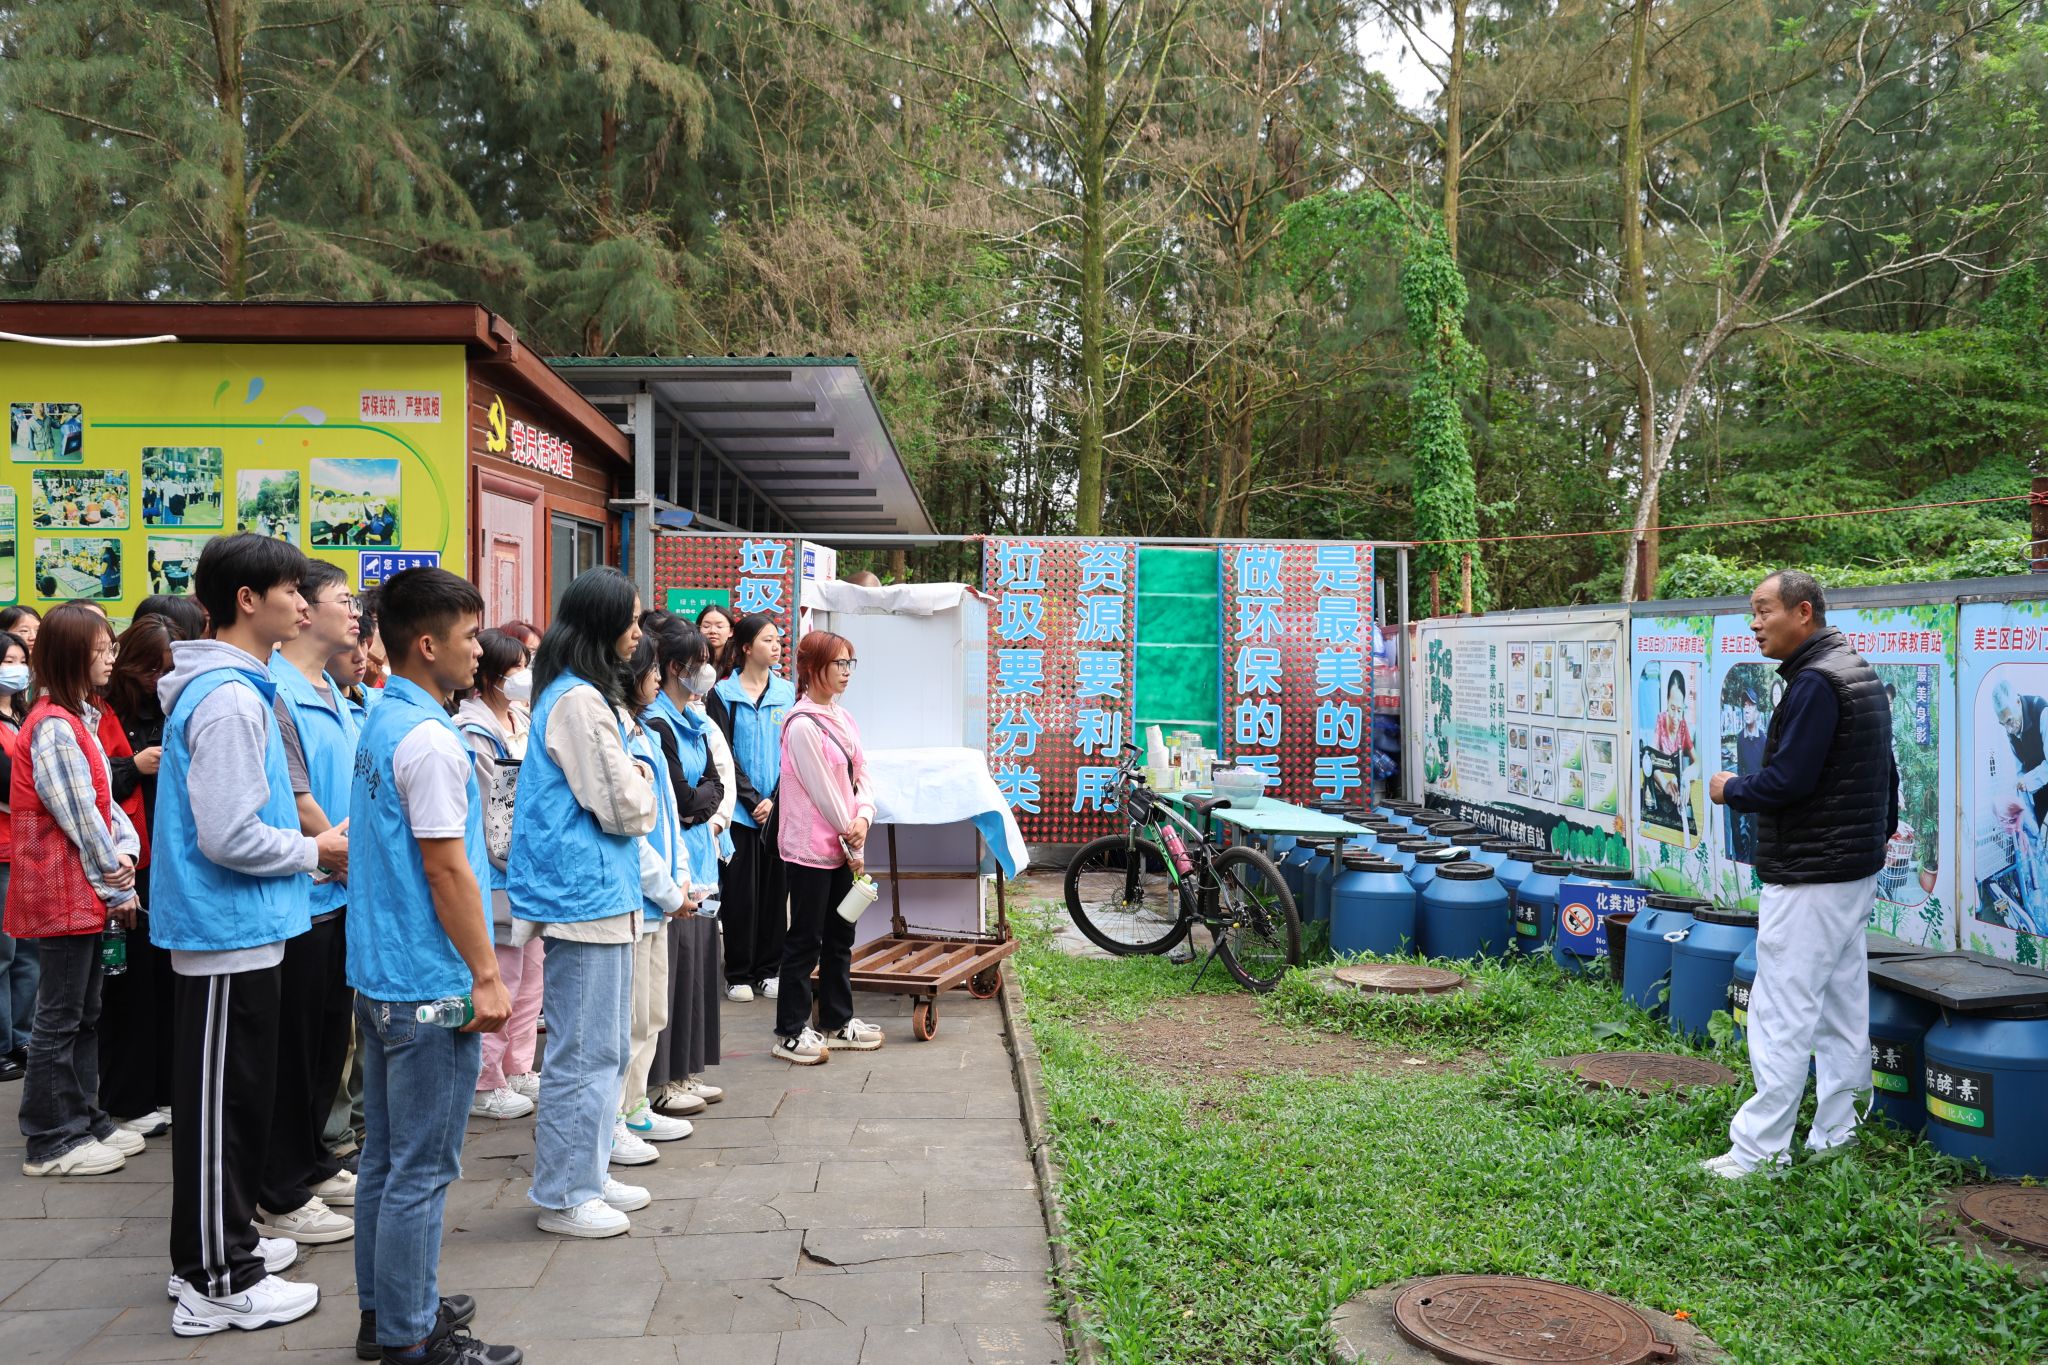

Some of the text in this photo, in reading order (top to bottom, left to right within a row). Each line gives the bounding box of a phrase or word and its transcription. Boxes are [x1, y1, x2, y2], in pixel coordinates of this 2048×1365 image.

[361, 395, 440, 417] 环保站内，严禁吸烟
[511, 420, 573, 479] 党员活动室
[1637, 636, 1705, 654] 美兰区白沙门环保教育站
[1721, 635, 1760, 654] 美兰区白沙
[1842, 630, 1942, 654] 区白沙门环保教育站
[993, 542, 1047, 815] 垃圾要分类
[1072, 543, 1127, 814] 资源要利用
[1312, 544, 1364, 801] 是最美的手
[1916, 665, 1927, 743] 最美身影
[1459, 803, 1546, 851] 美兰区白沙门环保教育站
[1596, 937, 1606, 945] No
[1596, 947, 1608, 955] the
